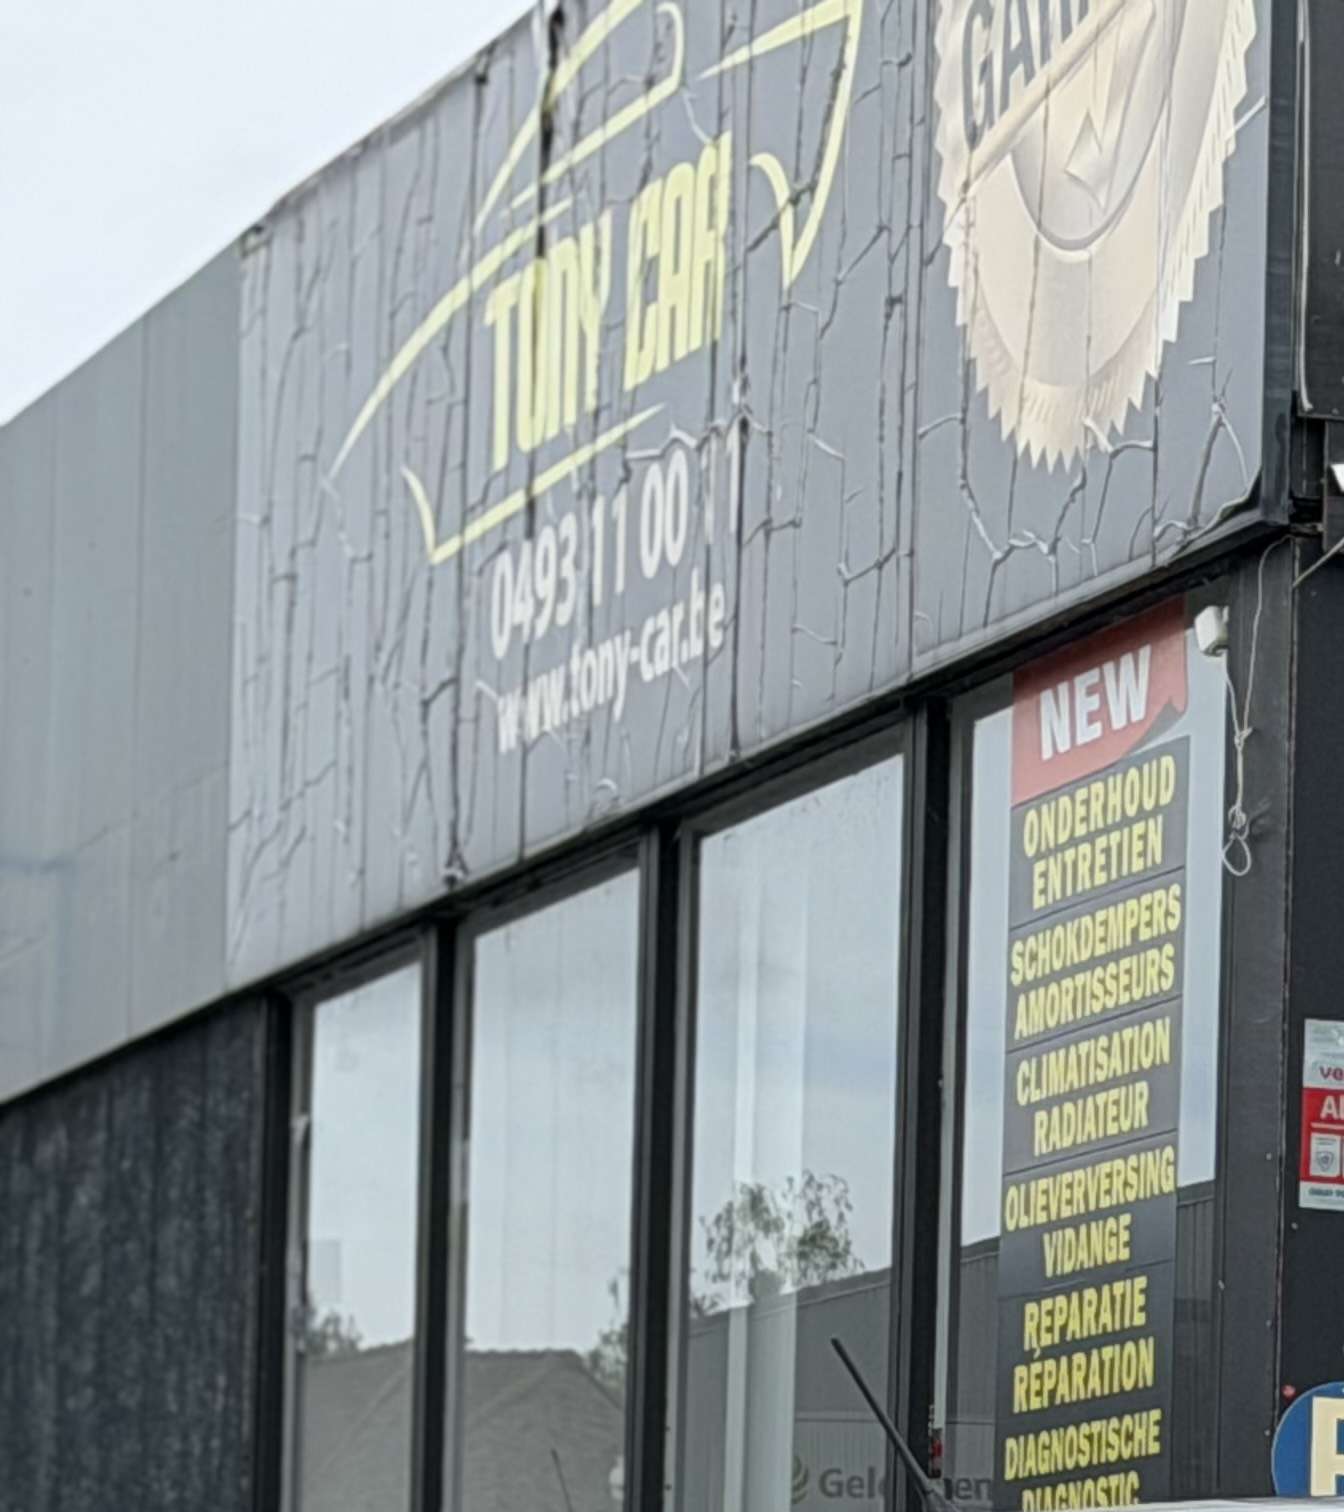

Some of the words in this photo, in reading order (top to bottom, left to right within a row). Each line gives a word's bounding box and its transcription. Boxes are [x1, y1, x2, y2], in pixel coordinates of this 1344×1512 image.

[484, 209, 612, 472] TONY
[624, 129, 733, 391] CAR
[491, 512, 577, 660] 0493
[639, 448, 688, 580] 00
[1040, 646, 1152, 761] NEW
[1023, 754, 1176, 857] ONDERHOUD
[1032, 815, 1163, 911] ENTRETIEN
[1011, 883, 1181, 986] SCHOKDEMPERS
[1014, 946, 1175, 1041] AMORTISSEURS
[1016, 1017, 1171, 1105] CLIMATISATION
[1034, 1081, 1149, 1157] RADIATEUR
[1005, 1145, 1176, 1232] OLIEVERVERSING
[1043, 1213, 1133, 1278] VIDANGE
[1024, 1275, 1148, 1351] REPARATIE
[1004, 1409, 1161, 1480] DIAGNOSTISCHE
